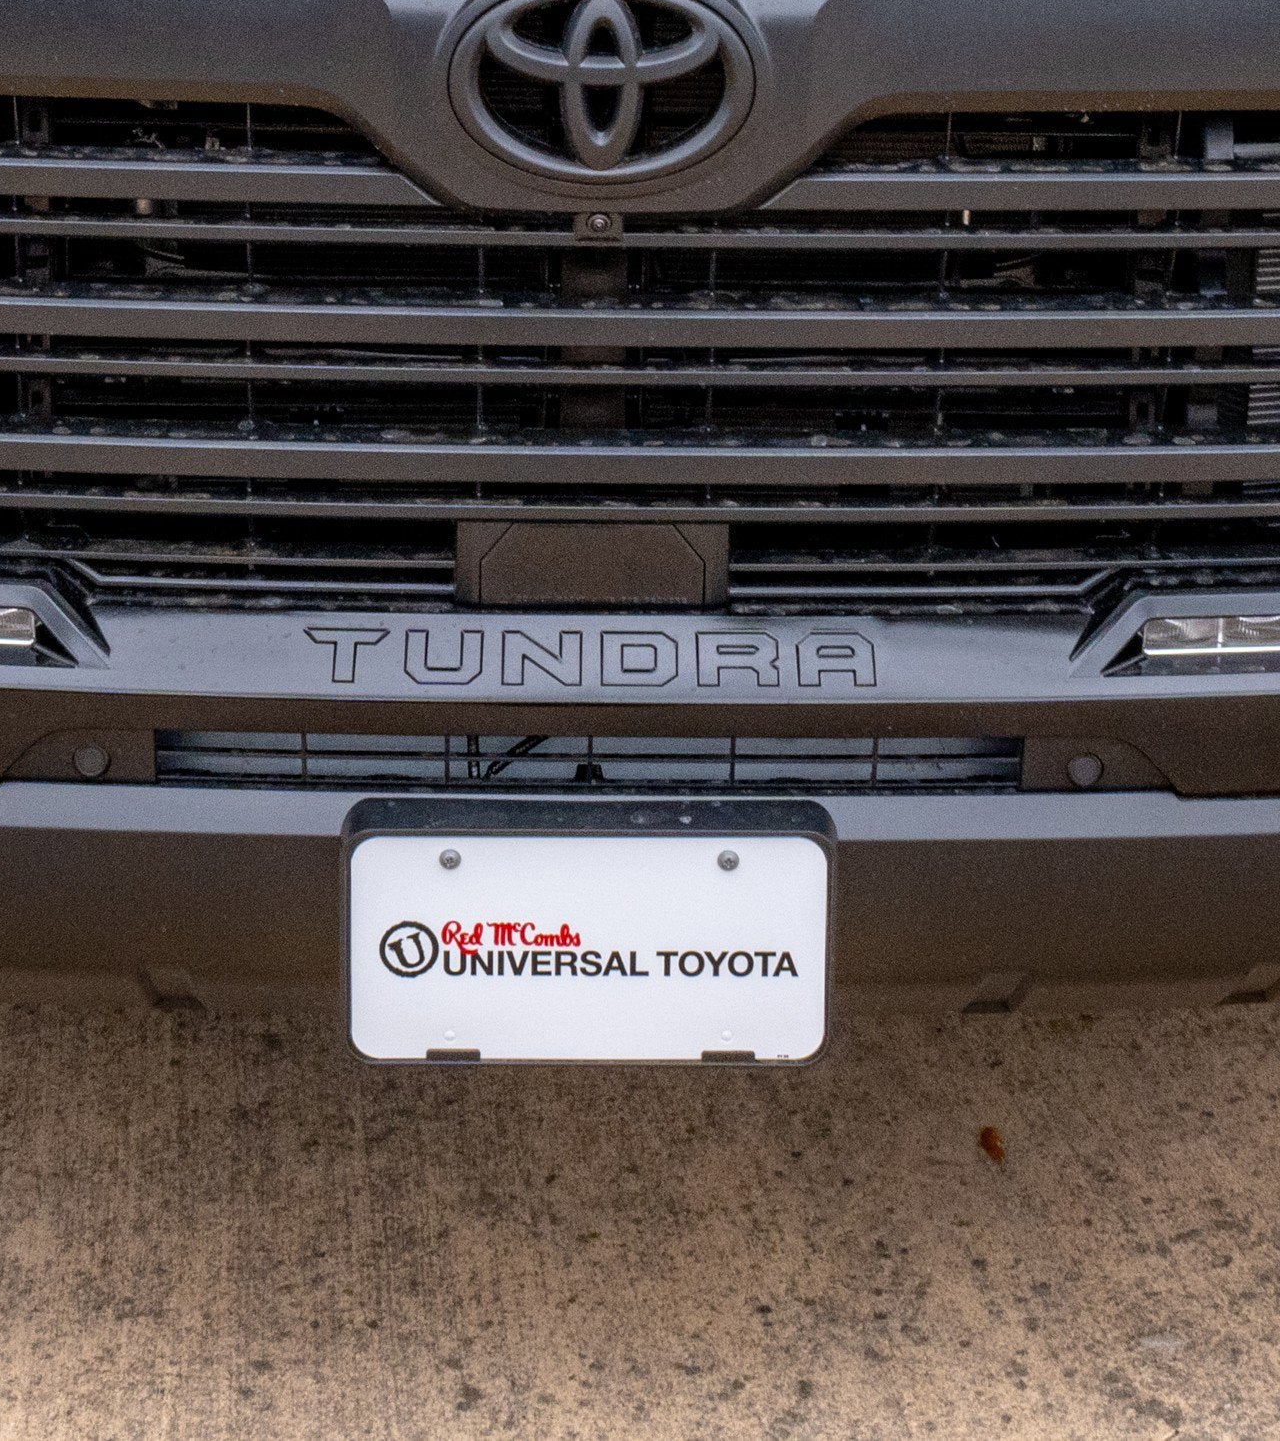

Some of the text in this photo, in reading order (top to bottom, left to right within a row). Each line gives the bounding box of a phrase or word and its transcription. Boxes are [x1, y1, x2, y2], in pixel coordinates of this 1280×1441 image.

[303, 627, 877, 687] TUNDRA
[441, 920, 581, 955] Red McCombs
[443, 950, 799, 977] UNIVERSAL TOYOTA
